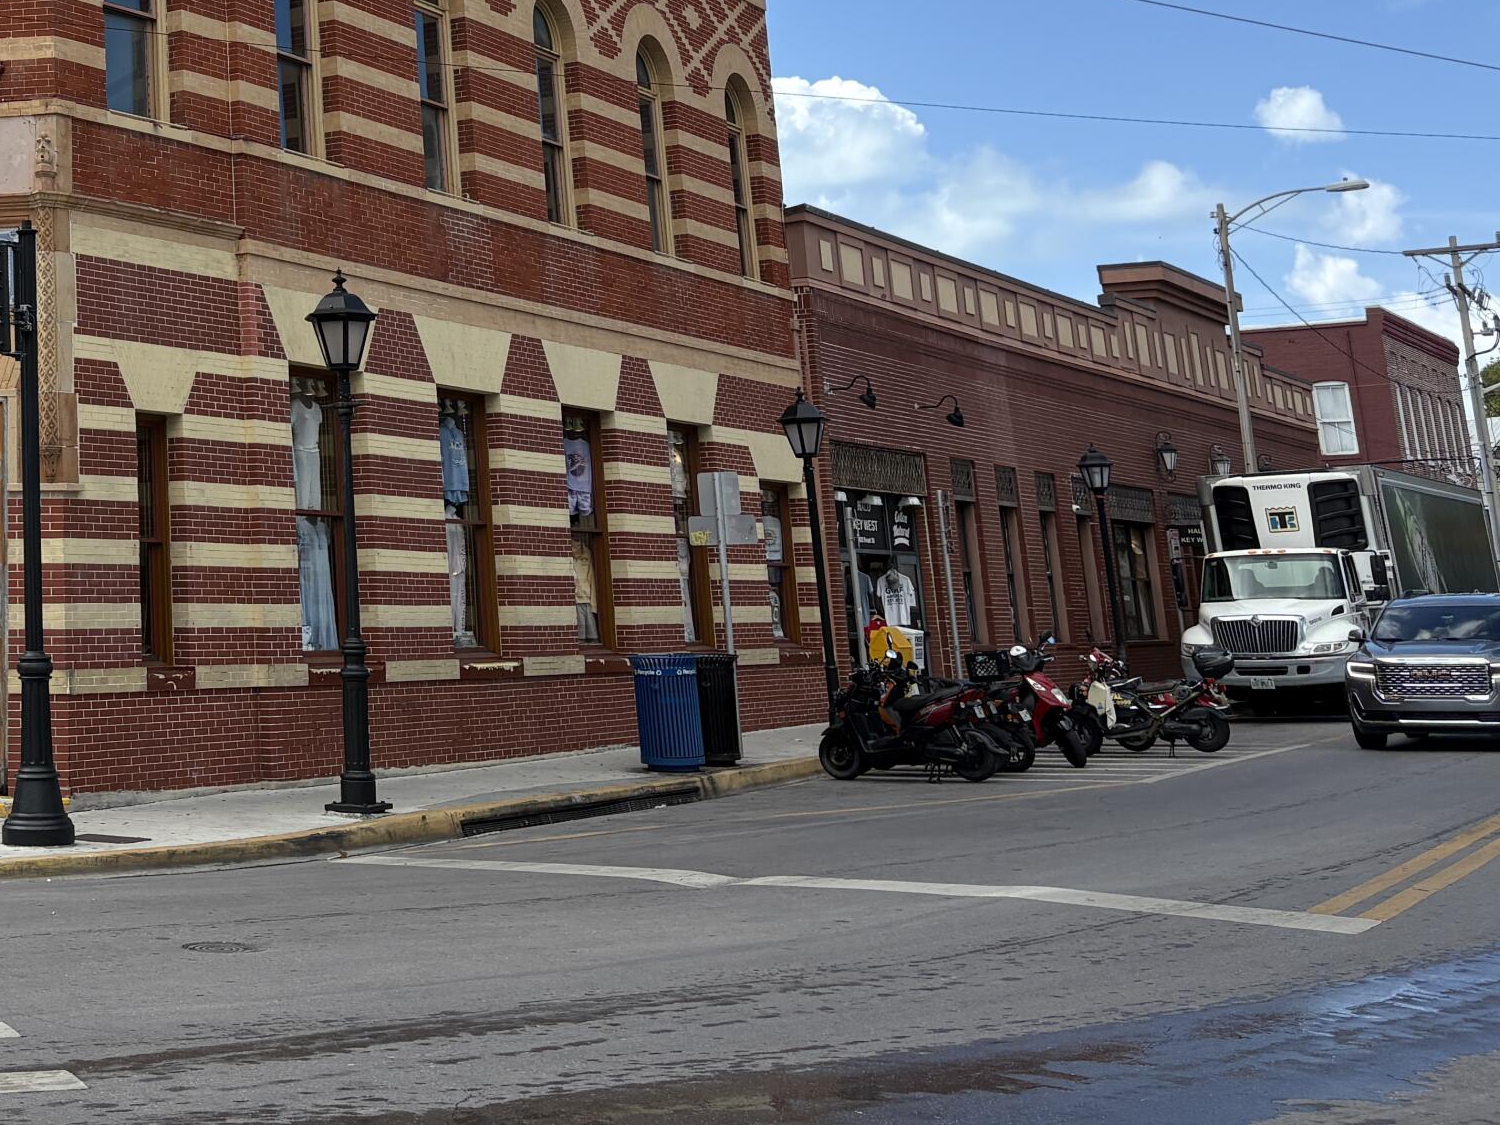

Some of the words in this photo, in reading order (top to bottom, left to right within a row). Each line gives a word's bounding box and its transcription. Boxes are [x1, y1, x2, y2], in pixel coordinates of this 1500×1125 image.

[1252, 483, 1283, 491] THERMO
[1283, 482, 1302, 490] KING
[864, 520, 878, 531] WEST
